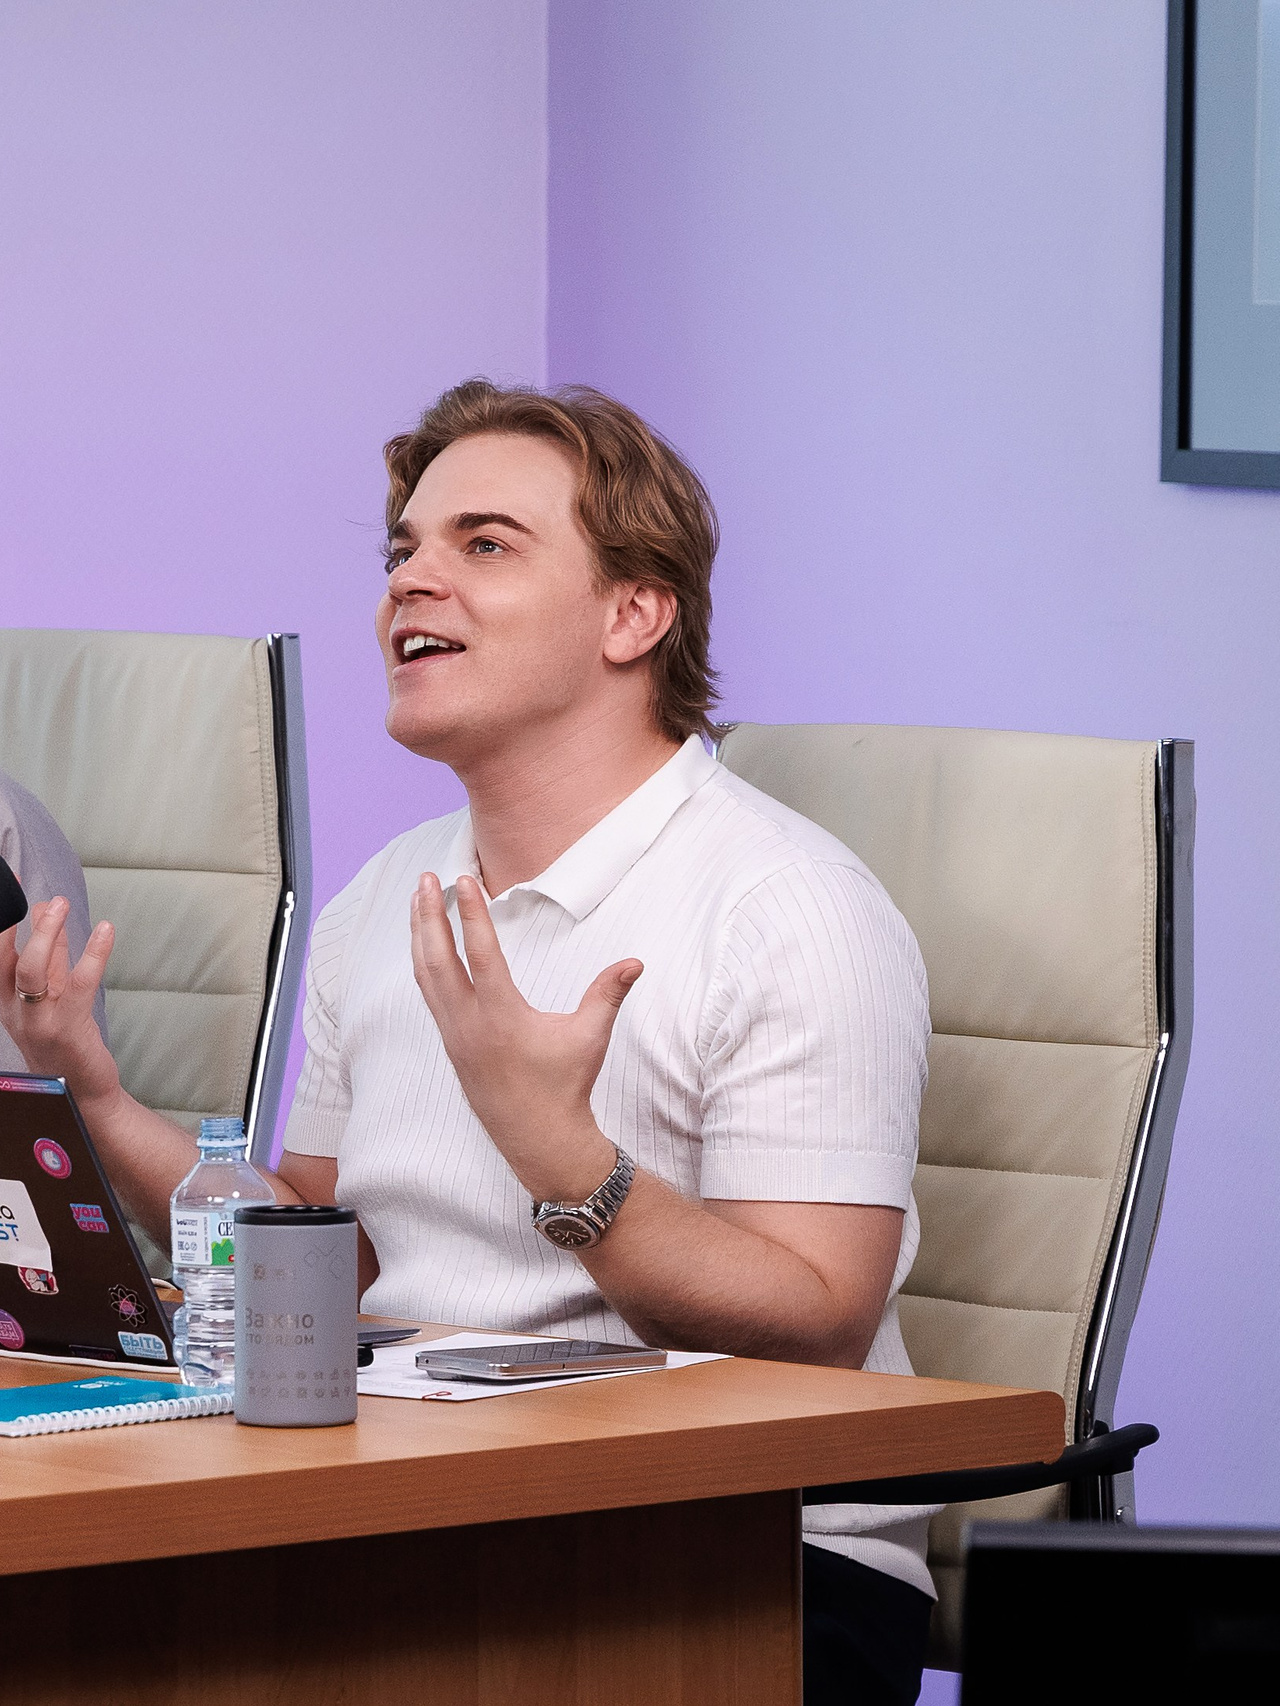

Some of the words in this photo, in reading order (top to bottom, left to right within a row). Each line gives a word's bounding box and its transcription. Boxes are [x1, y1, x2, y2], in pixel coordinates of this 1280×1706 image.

[72, 1206, 102, 1219] you
[78, 1221, 108, 1232] can
[120, 1335, 163, 1349] БЫТЬ
